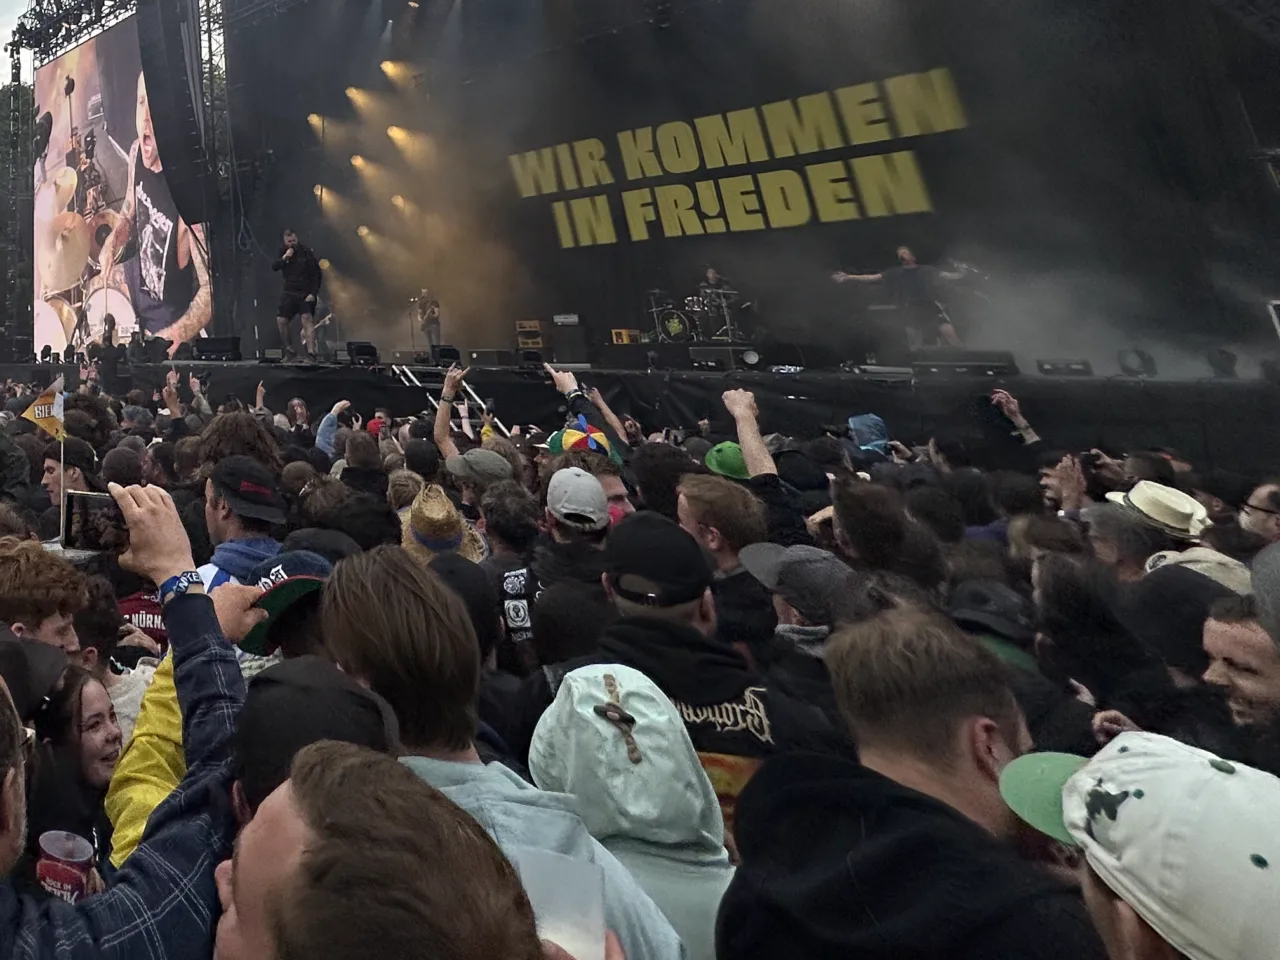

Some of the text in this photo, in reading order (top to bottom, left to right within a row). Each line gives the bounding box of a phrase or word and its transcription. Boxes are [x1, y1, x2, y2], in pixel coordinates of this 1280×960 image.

[509, 67, 968, 198] WIR KOMMEN
[552, 195, 617, 249] IN
[132, 608, 166, 631] NÜRN
